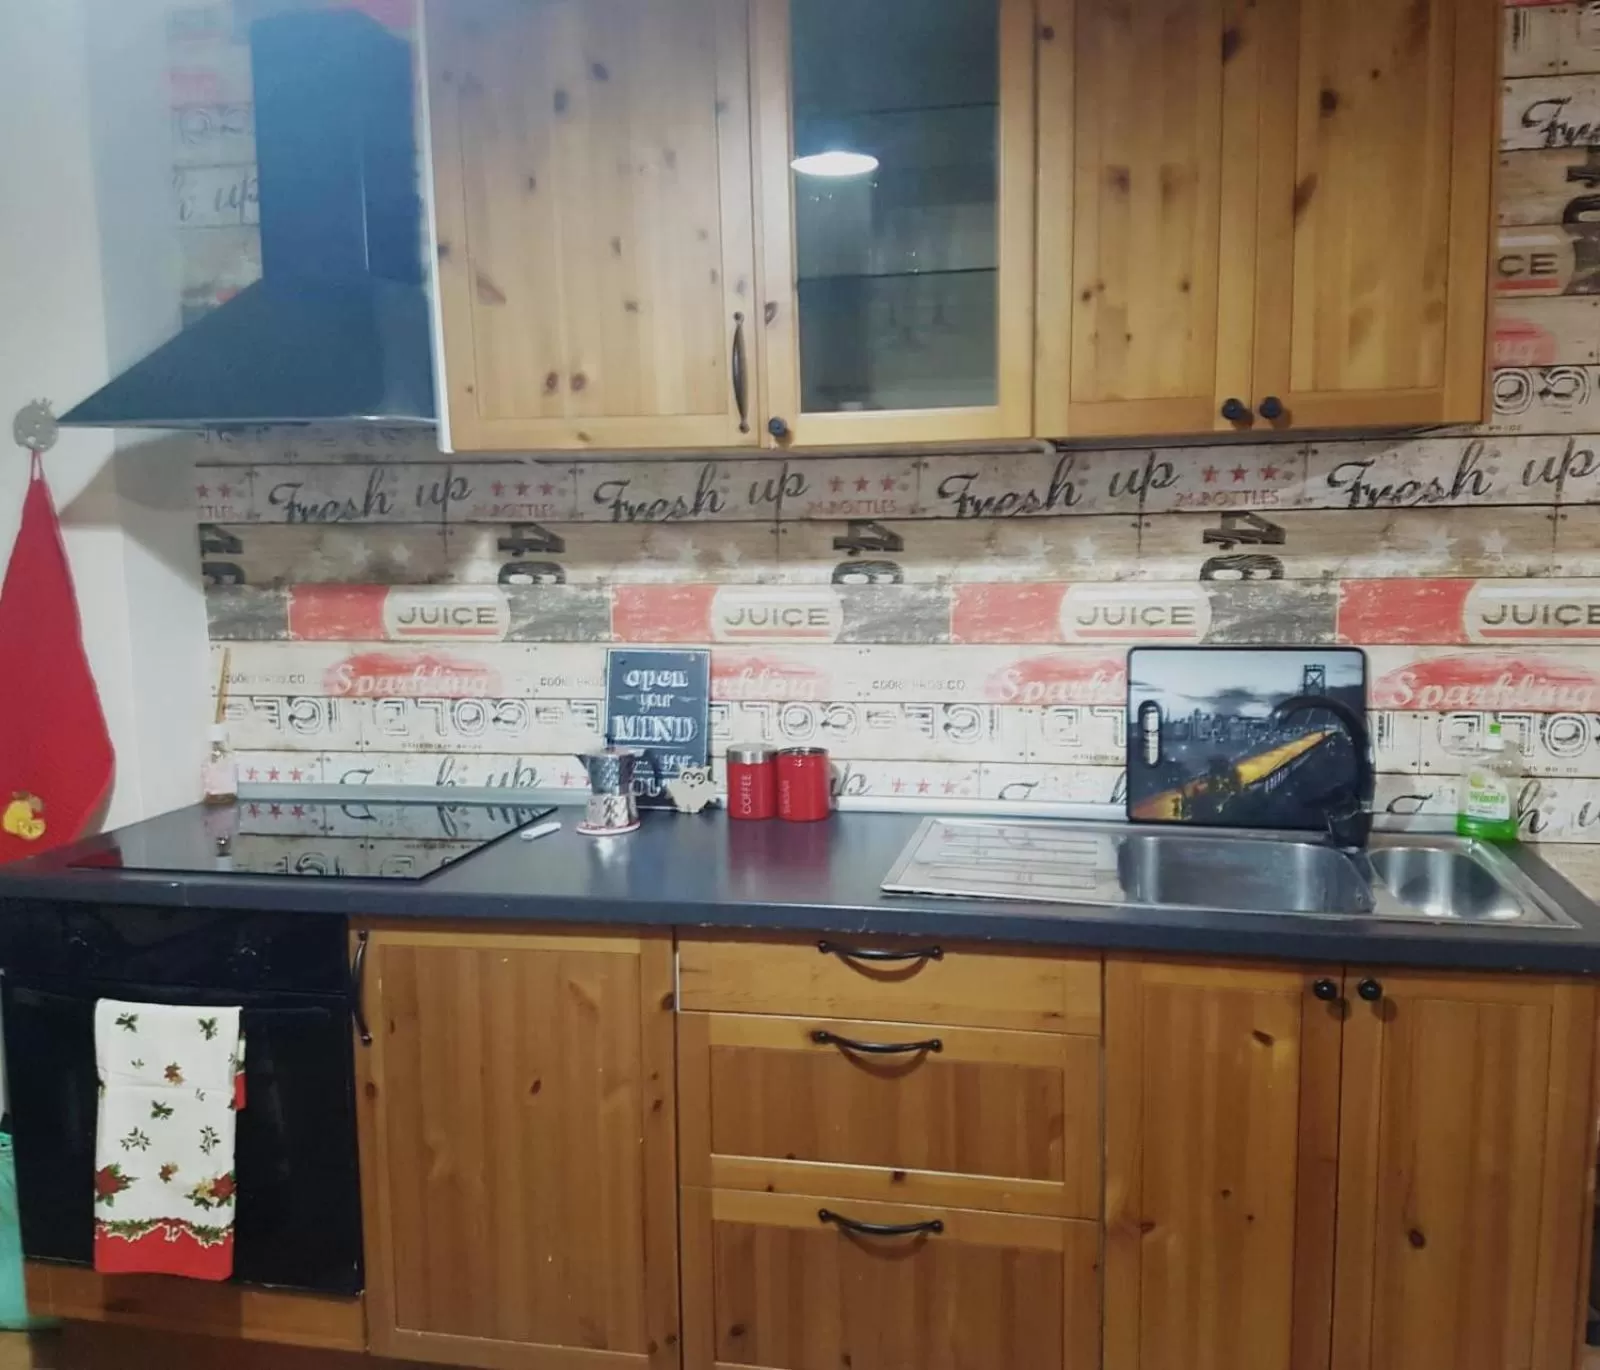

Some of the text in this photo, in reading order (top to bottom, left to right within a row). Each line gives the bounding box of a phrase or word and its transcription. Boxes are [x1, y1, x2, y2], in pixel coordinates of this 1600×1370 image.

[937, 450, 1182, 518] Fresh up
[1327, 437, 1600, 508] Fresh up
[268, 466, 473, 523] Fresh up
[593, 462, 810, 522] Fresh up
[1198, 488, 1280, 507] BOTTLES
[397, 605, 498, 628] JUICE
[724, 607, 831, 629] JUICE
[1075, 605, 1197, 628] JUICE
[624, 670, 689, 690] open
[639, 694, 674, 713] your
[612, 715, 699, 743] MIND
[741, 774, 752, 815] COFFEE
